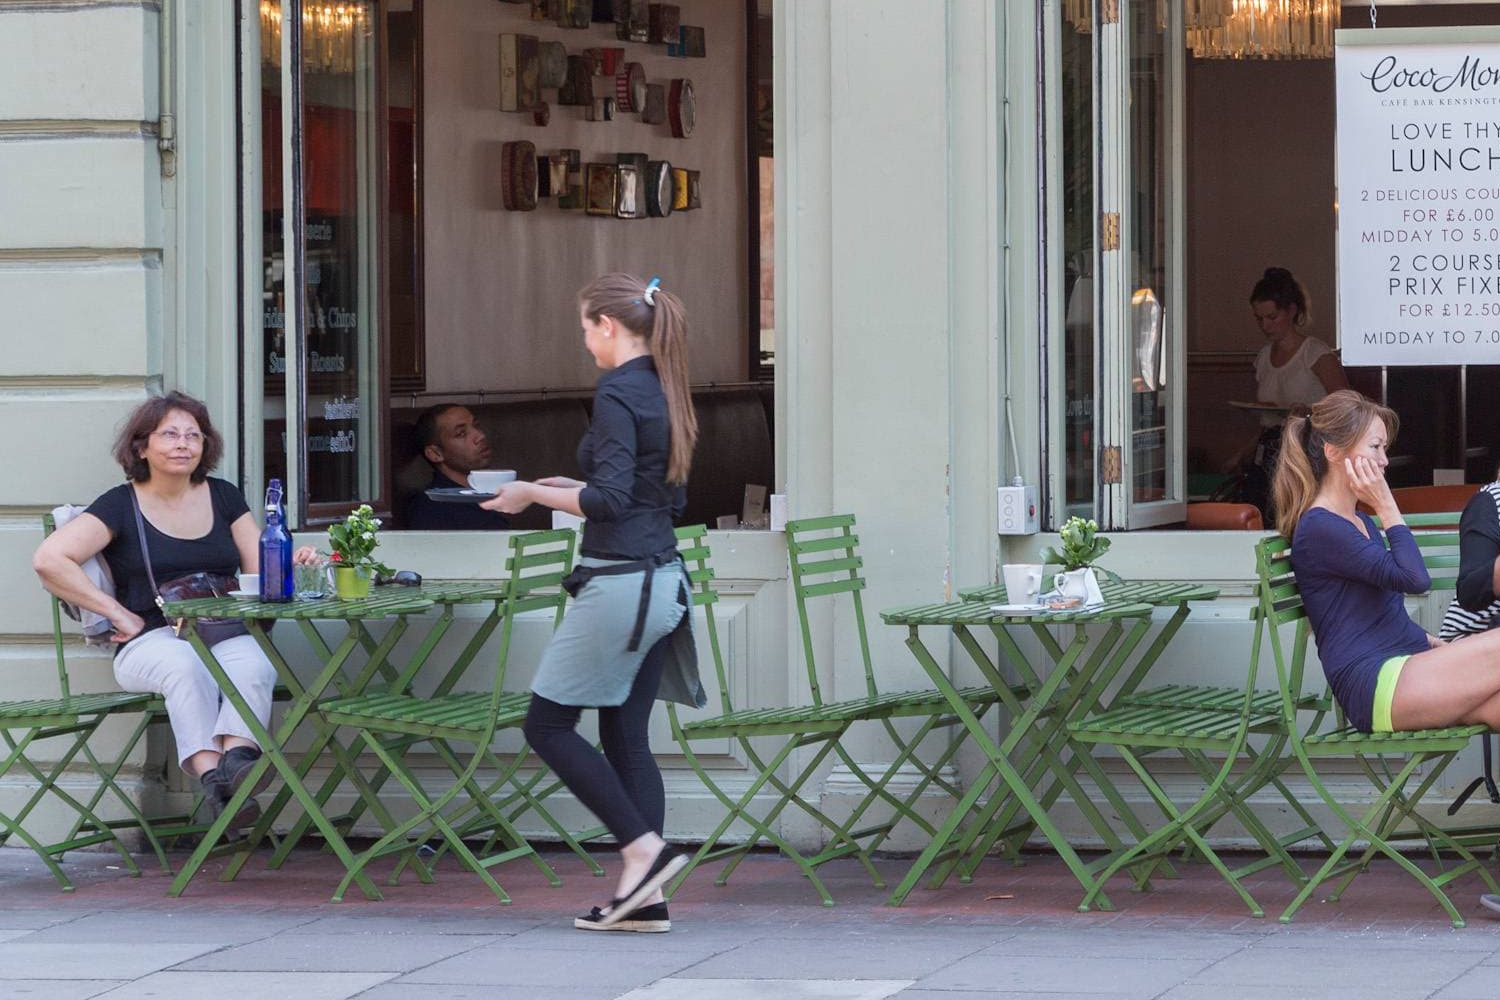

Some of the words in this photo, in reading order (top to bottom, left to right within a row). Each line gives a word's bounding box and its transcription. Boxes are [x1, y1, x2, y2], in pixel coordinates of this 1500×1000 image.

[1360, 55, 1437, 93] Coco
[1413, 98, 1434, 107] BAR
[1391, 122, 1452, 140] LOVE
[1361, 190, 1369, 202] 2
[1376, 188, 1458, 202] DELICIOUS
[1403, 209, 1437, 223] FOR
[1446, 208, 1494, 222] £6.00
[1361, 229, 1433, 243] MIDDAY
[1441, 228, 1464, 242] TO
[1389, 255, 1401, 272] 2
[1389, 277, 1444, 296] PRIX
[1399, 303, 1433, 317] FOR
[1442, 302, 1500, 317] £12.50
[327, 306, 357, 334] Chips
[1363, 331, 1434, 345] MIDDAY
[1443, 330, 1466, 344] TO
[310, 351, 345, 373] Roasts
